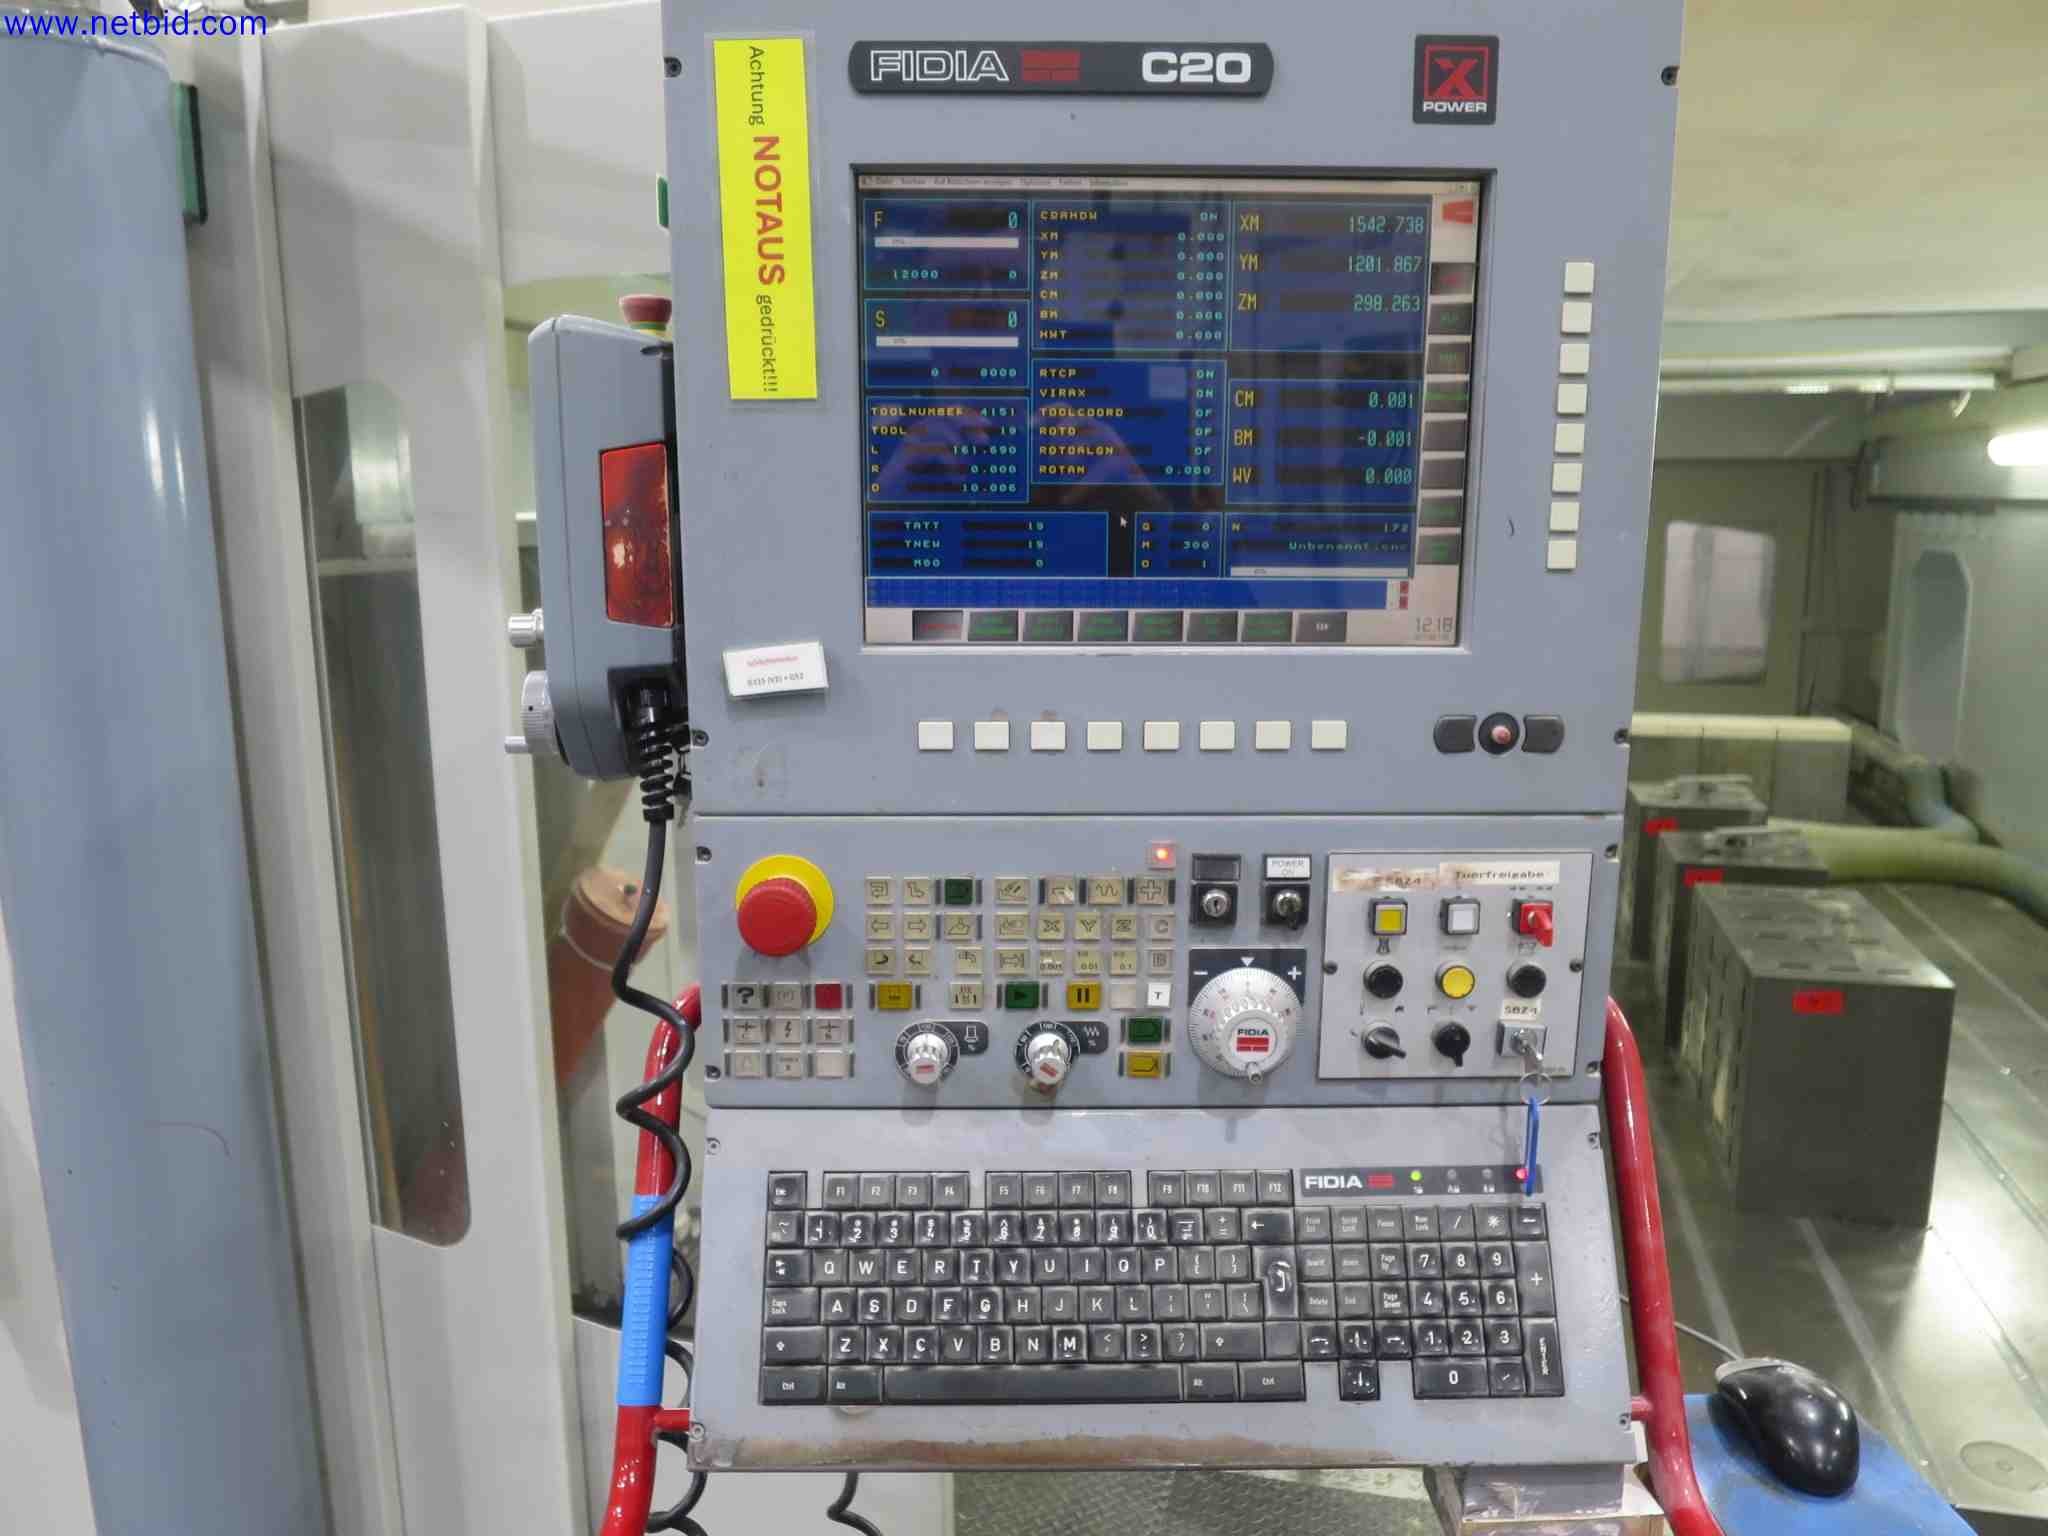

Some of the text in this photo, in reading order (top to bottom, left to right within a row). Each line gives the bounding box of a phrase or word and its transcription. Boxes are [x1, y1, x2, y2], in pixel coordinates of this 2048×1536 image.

[870, 51, 1251, 83] FIDIA C20
[748, 46, 765, 126] Achtung
[1423, 101, 1487, 113] POWER
[753, 136, 785, 285] NOTAUS
[874, 211, 1018, 229] F 0
[1240, 215, 1424, 234] XM 1542.738
[1040, 252, 1058, 260] YM
[1239, 253, 1421, 273] YM 1201.867
[1040, 271, 1058, 280] ZM
[1238, 293, 1256, 311] ZM
[875, 310, 885, 328] S
[1040, 368, 1076, 378] RTCP
[1235, 391, 1254, 407] CM
[871, 407, 963, 417] TOOLNUMBER
[1040, 408, 1124, 417] TOOLCOORD
[872, 426, 906, 435] TOOL
[1234, 429, 1253, 446] BM
[872, 446, 878, 455] L
[872, 465, 879, 473] R
[1043, 920, 1060, 933] X
[1080, 920, 1097, 933] Y
[1155, 920, 1168, 933] C
[1238, 1028, 1269, 1036] FIDIA
[1304, 1175, 1363, 1189] FIDIA
[854, 1228, 862, 1239] 2
[890, 1227, 898, 1238] 3
[1045, 1259, 1055, 1272] U
[1119, 1259, 1129, 1272] O
[1155, 1258, 1165, 1272] P
[1420, 1254, 1430, 1267] 7
[1456, 1254, 1465, 1267] 8
[1492, 1253, 1501, 1266] 9
[824, 1261, 834, 1274] Q
[858, 1261, 874, 1274] W
[897, 1261, 907, 1274] E
[935, 1260, 945, 1273] R
[973, 1260, 981, 1273] T
[1009, 1260, 1018, 1273] Y
[1055, 1298, 1063, 1312] J
[1092, 1298, 1103, 1312] K
[1130, 1298, 1138, 1311] L
[1424, 1292, 1432, 1306] 4
[1459, 1292, 1469, 1305] 5
[1496, 1292, 1505, 1305] 6
[831, 1300, 843, 1313] A
[869, 1300, 880, 1313] S
[906, 1299, 917, 1313] D
[943, 1299, 953, 1312] F
[980, 1300, 991, 1312] G
[1018, 1299, 1028, 1312] H
[1064, 1337, 1076, 1350] M
[1428, 1332, 1435, 1345] 1
[1463, 1331, 1472, 1345] 2
[1500, 1331, 1509, 1344] 3
[841, 1338, 851, 1352] Z
[879, 1338, 889, 1352] X
[916, 1338, 926, 1351] C
[953, 1338, 963, 1351] V
[990, 1338, 1000, 1351] B
[1028, 1338, 1039, 1351] N
[1449, 1370, 1458, 1384] 0
